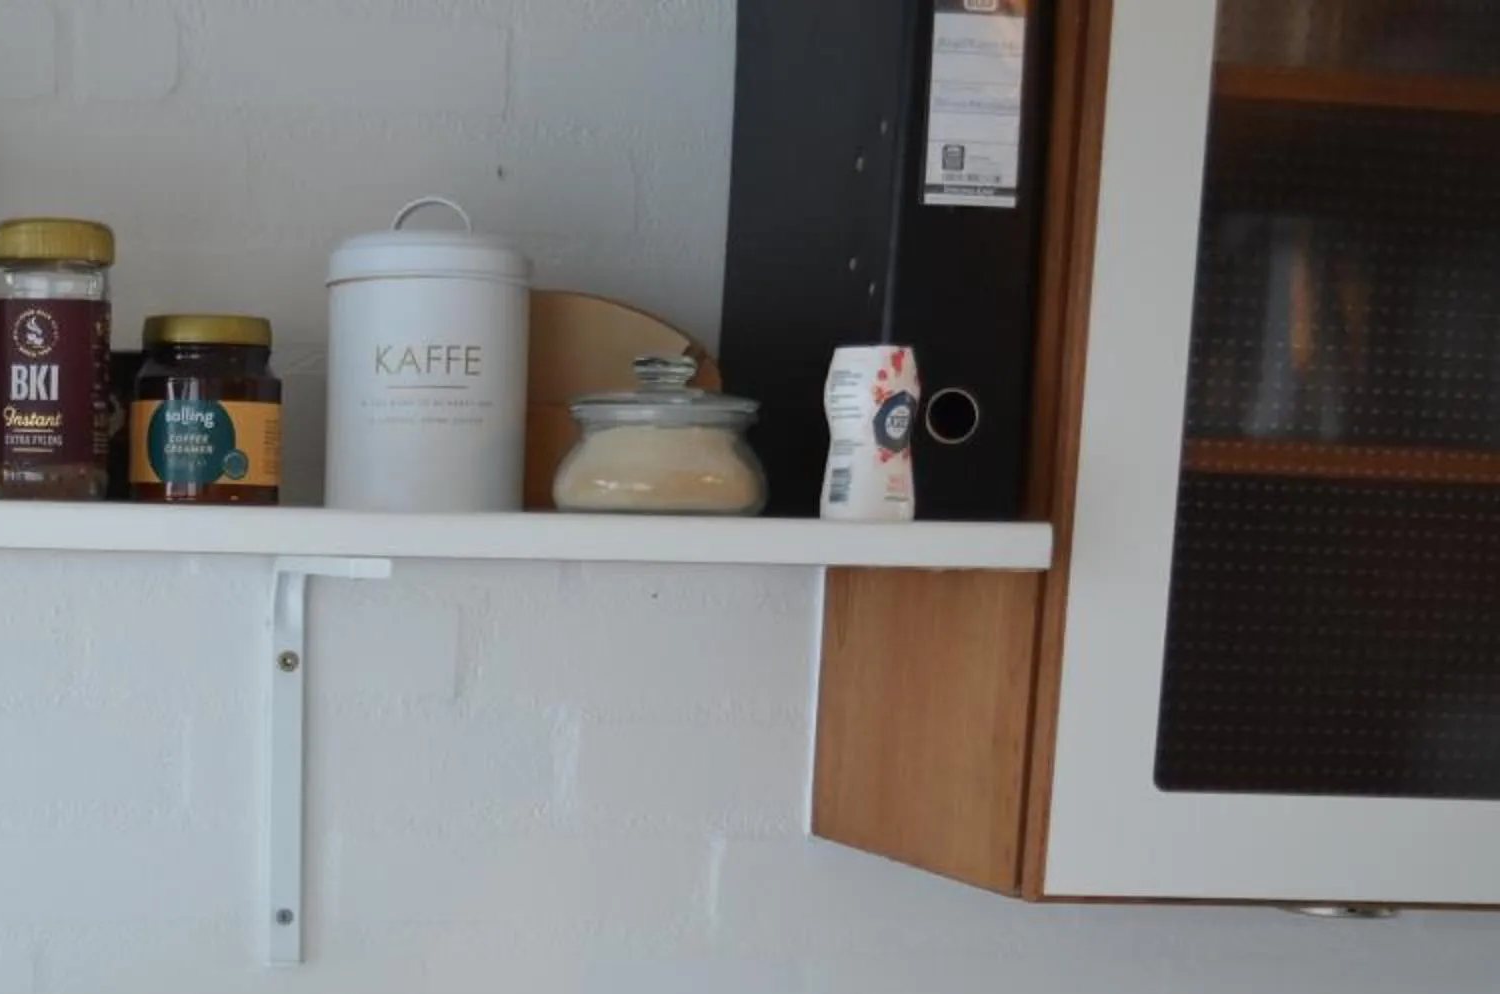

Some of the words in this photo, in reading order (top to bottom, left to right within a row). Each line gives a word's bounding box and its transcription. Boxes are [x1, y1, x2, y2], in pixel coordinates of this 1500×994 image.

[374, 344, 482, 377] KAFFE
[10, 364, 60, 401] BKI
[3, 404, 63, 428] Instant
